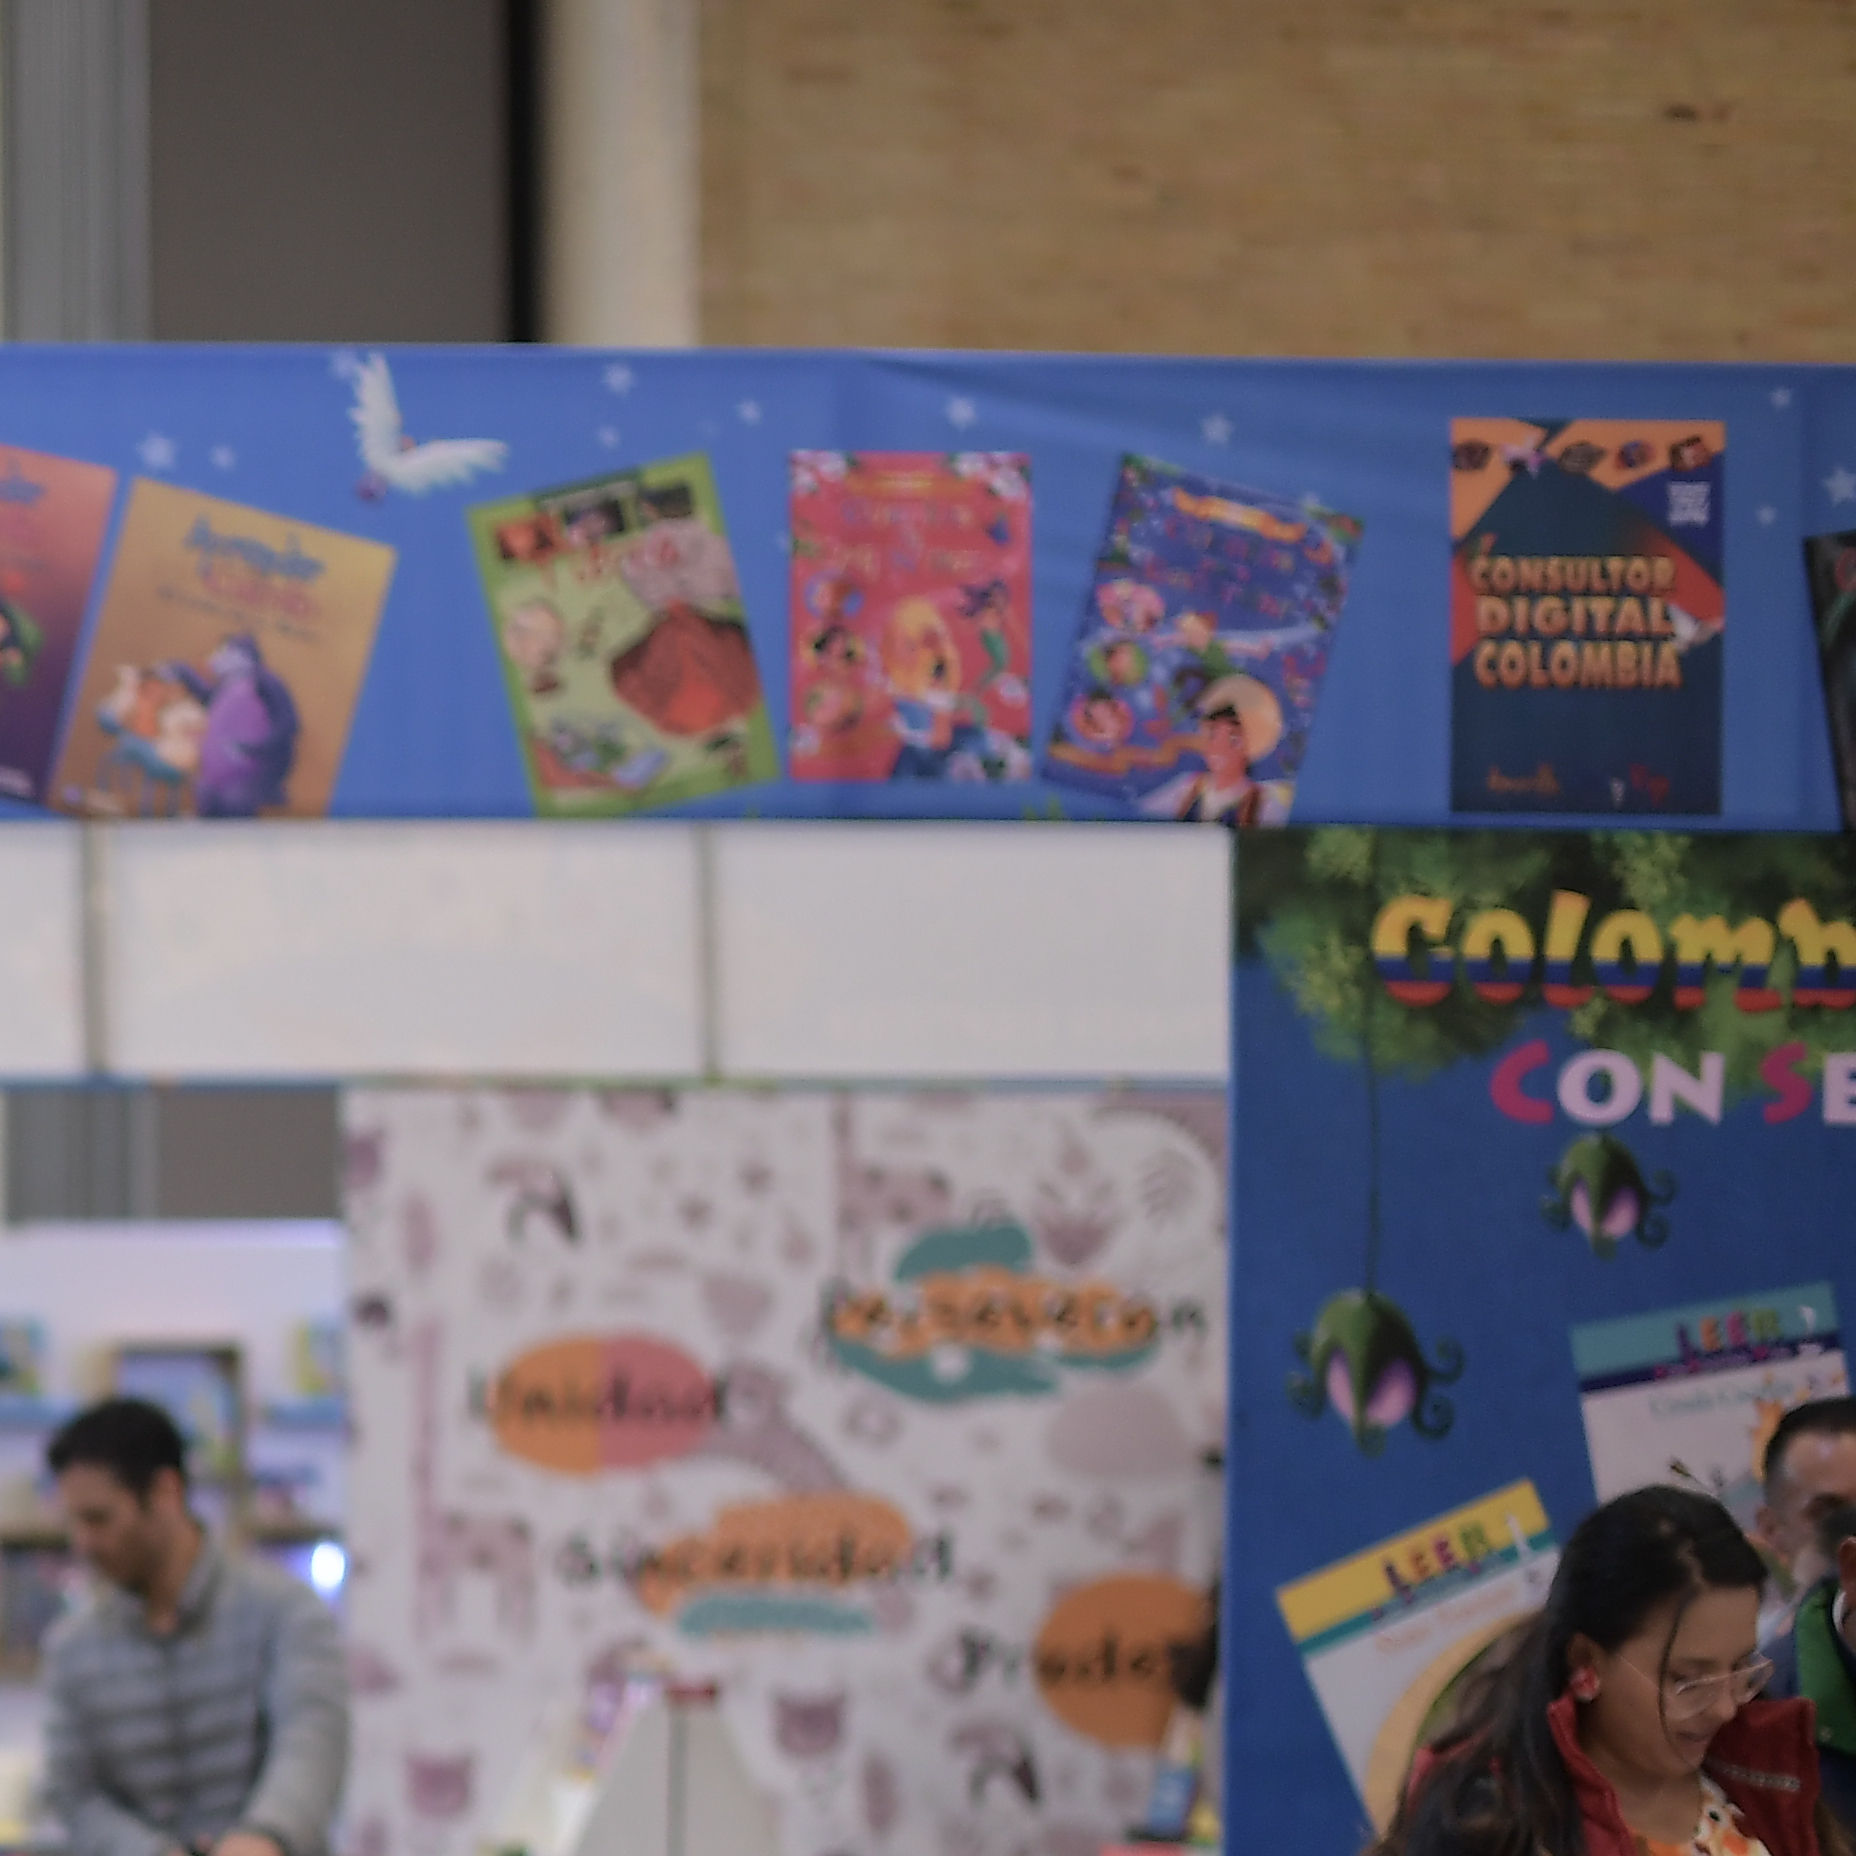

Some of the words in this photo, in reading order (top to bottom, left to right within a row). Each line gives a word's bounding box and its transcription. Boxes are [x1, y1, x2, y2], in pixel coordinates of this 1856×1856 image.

[1466, 554, 1677, 595] CONSULTOR
[1474, 593, 1675, 637] DIGITAL
[1473, 639, 1683, 690] COLOMBIA
[1490, 1039, 1726, 1127] CON
